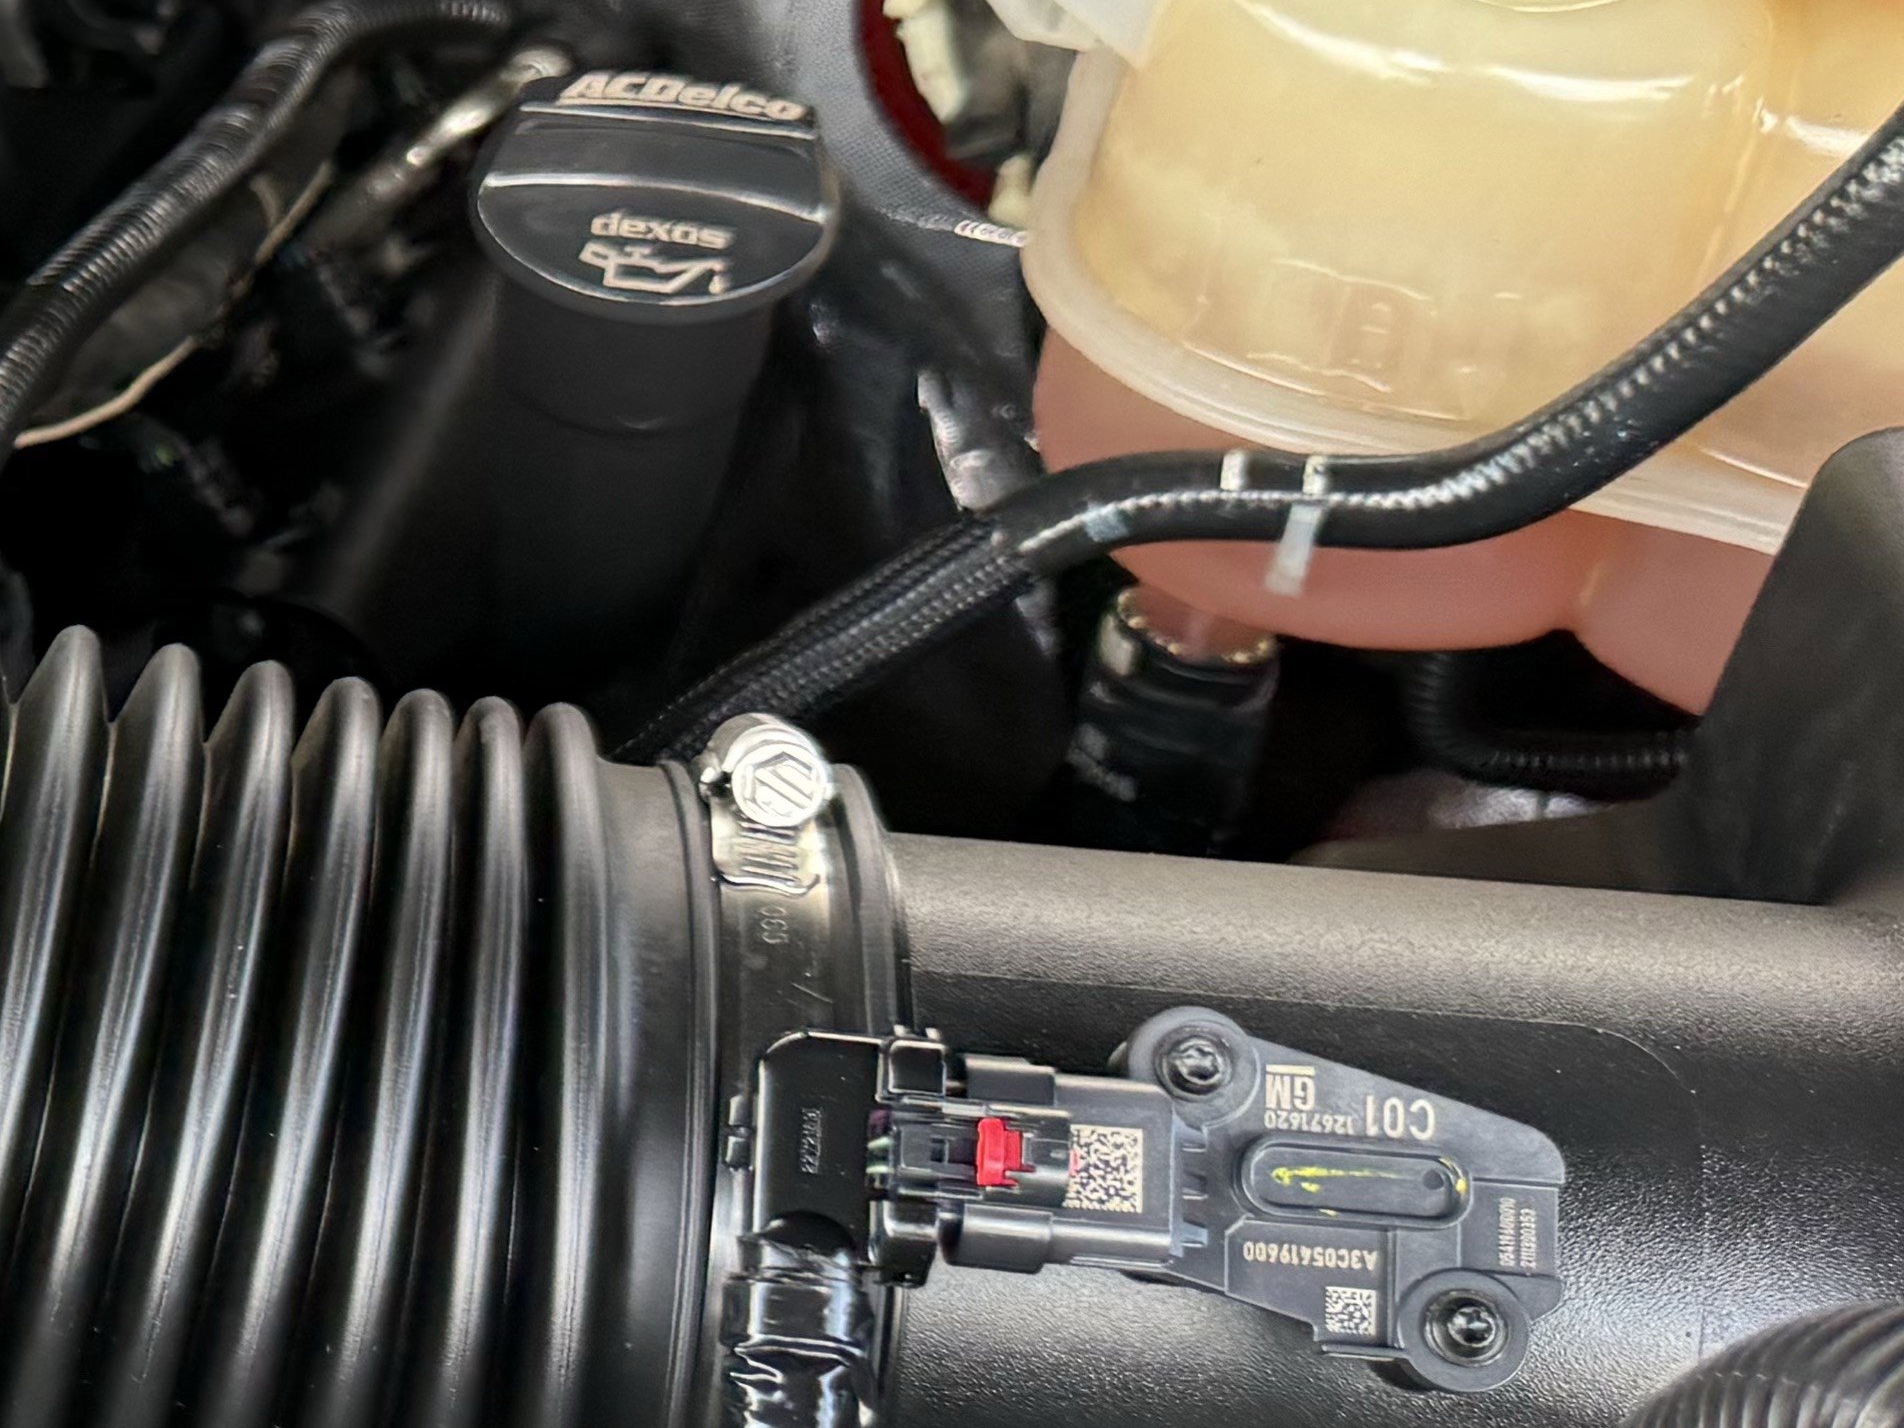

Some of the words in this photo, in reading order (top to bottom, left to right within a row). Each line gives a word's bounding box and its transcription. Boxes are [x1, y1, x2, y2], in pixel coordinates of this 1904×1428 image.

[556, 71, 806, 122] ACDelco
[591, 212, 736, 250] dexos
[1265, 1073, 1316, 1112] GM
[1364, 1094, 1436, 1142] C01
[1243, 1241, 1378, 1271] A3C05419600
